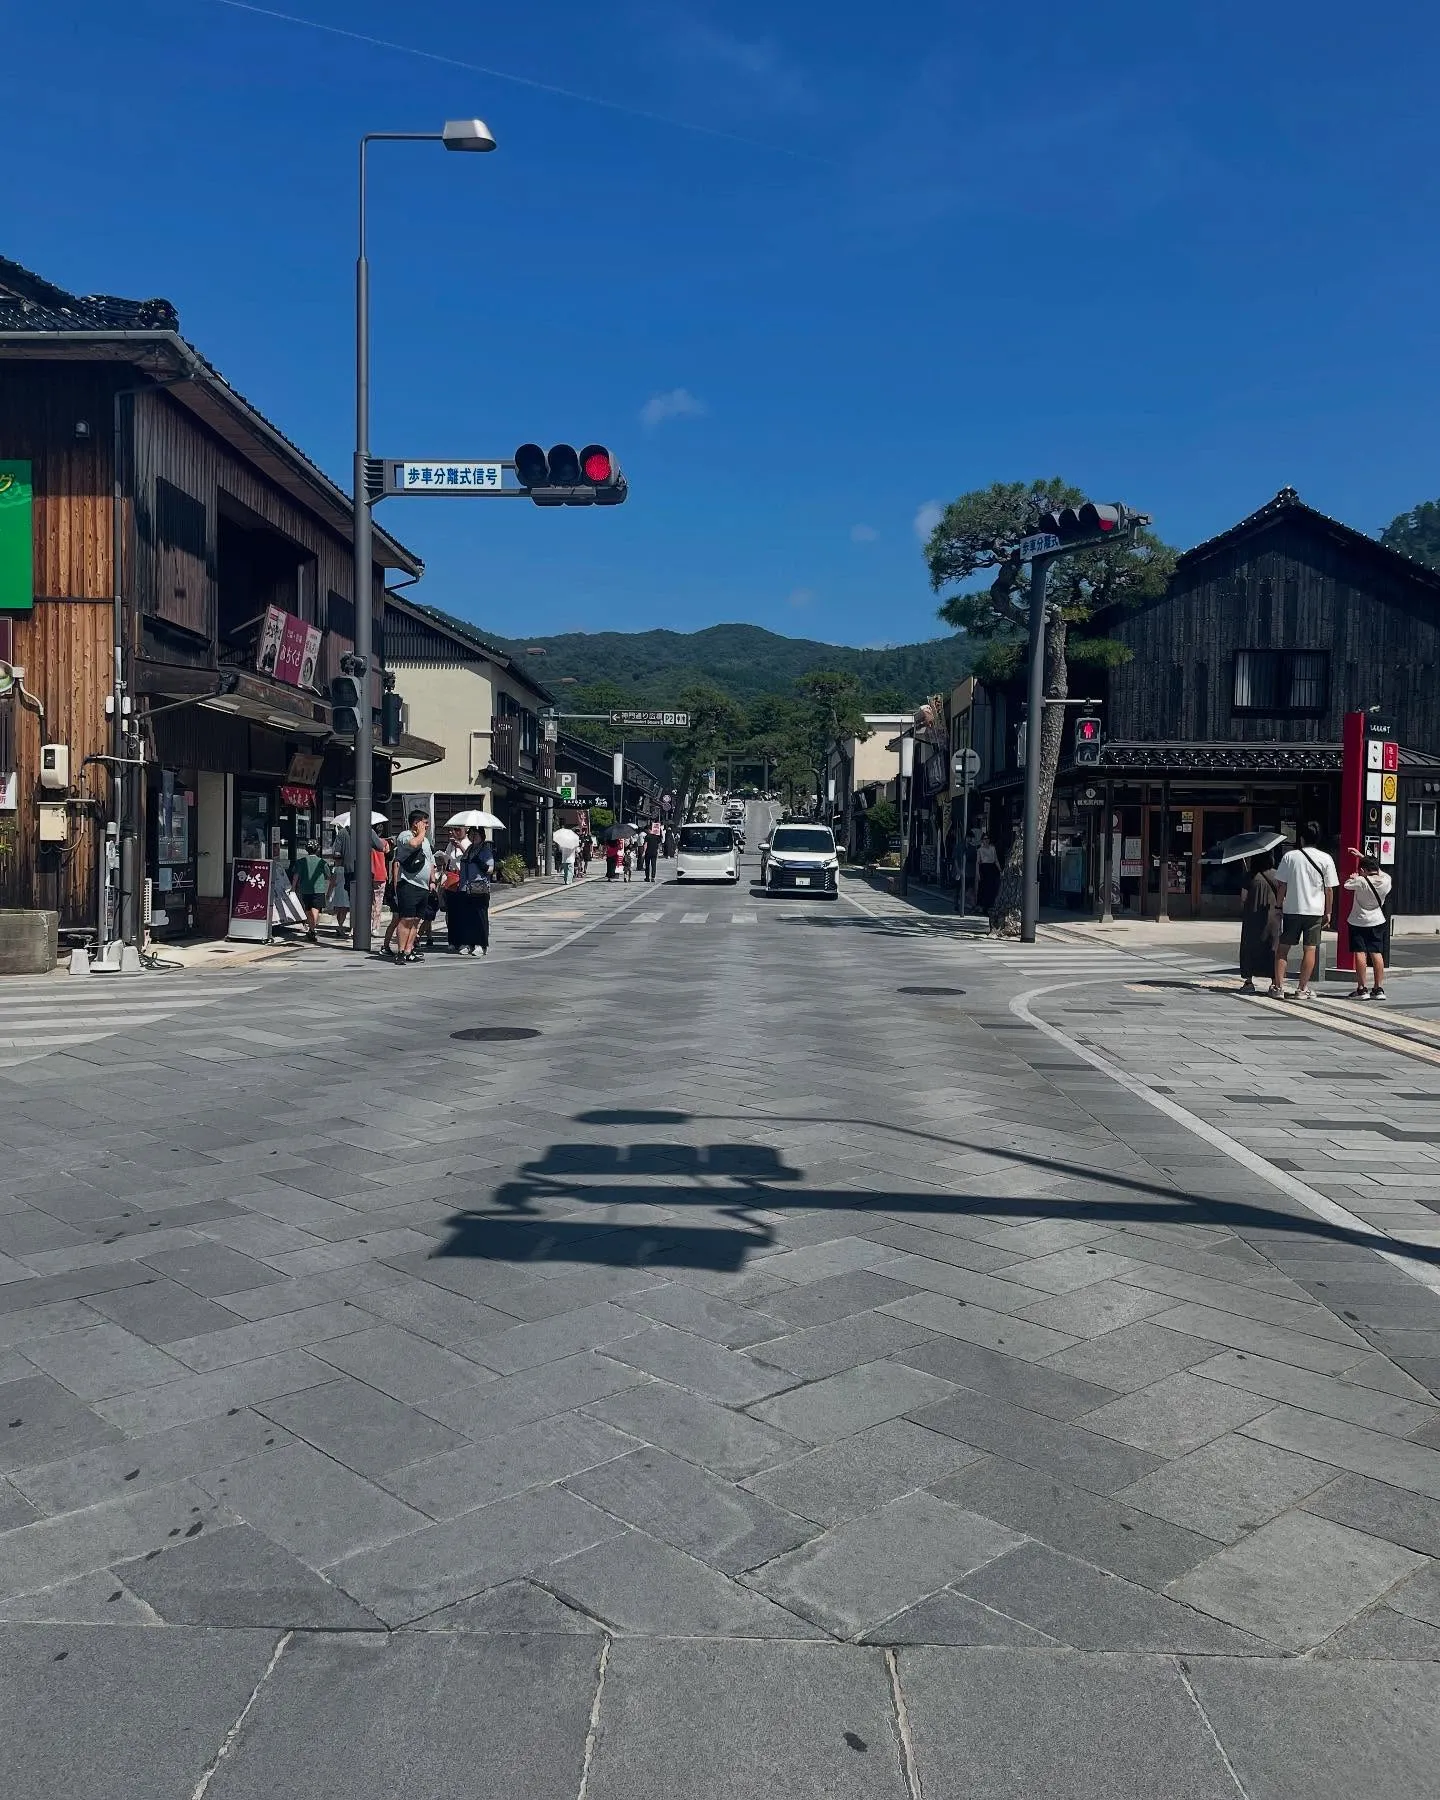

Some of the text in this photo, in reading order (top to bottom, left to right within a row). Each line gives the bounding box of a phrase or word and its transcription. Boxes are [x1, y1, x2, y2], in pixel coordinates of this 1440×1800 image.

[408, 467, 498, 485] 歩車分離式信号
[561, 774, 572, 787] P
